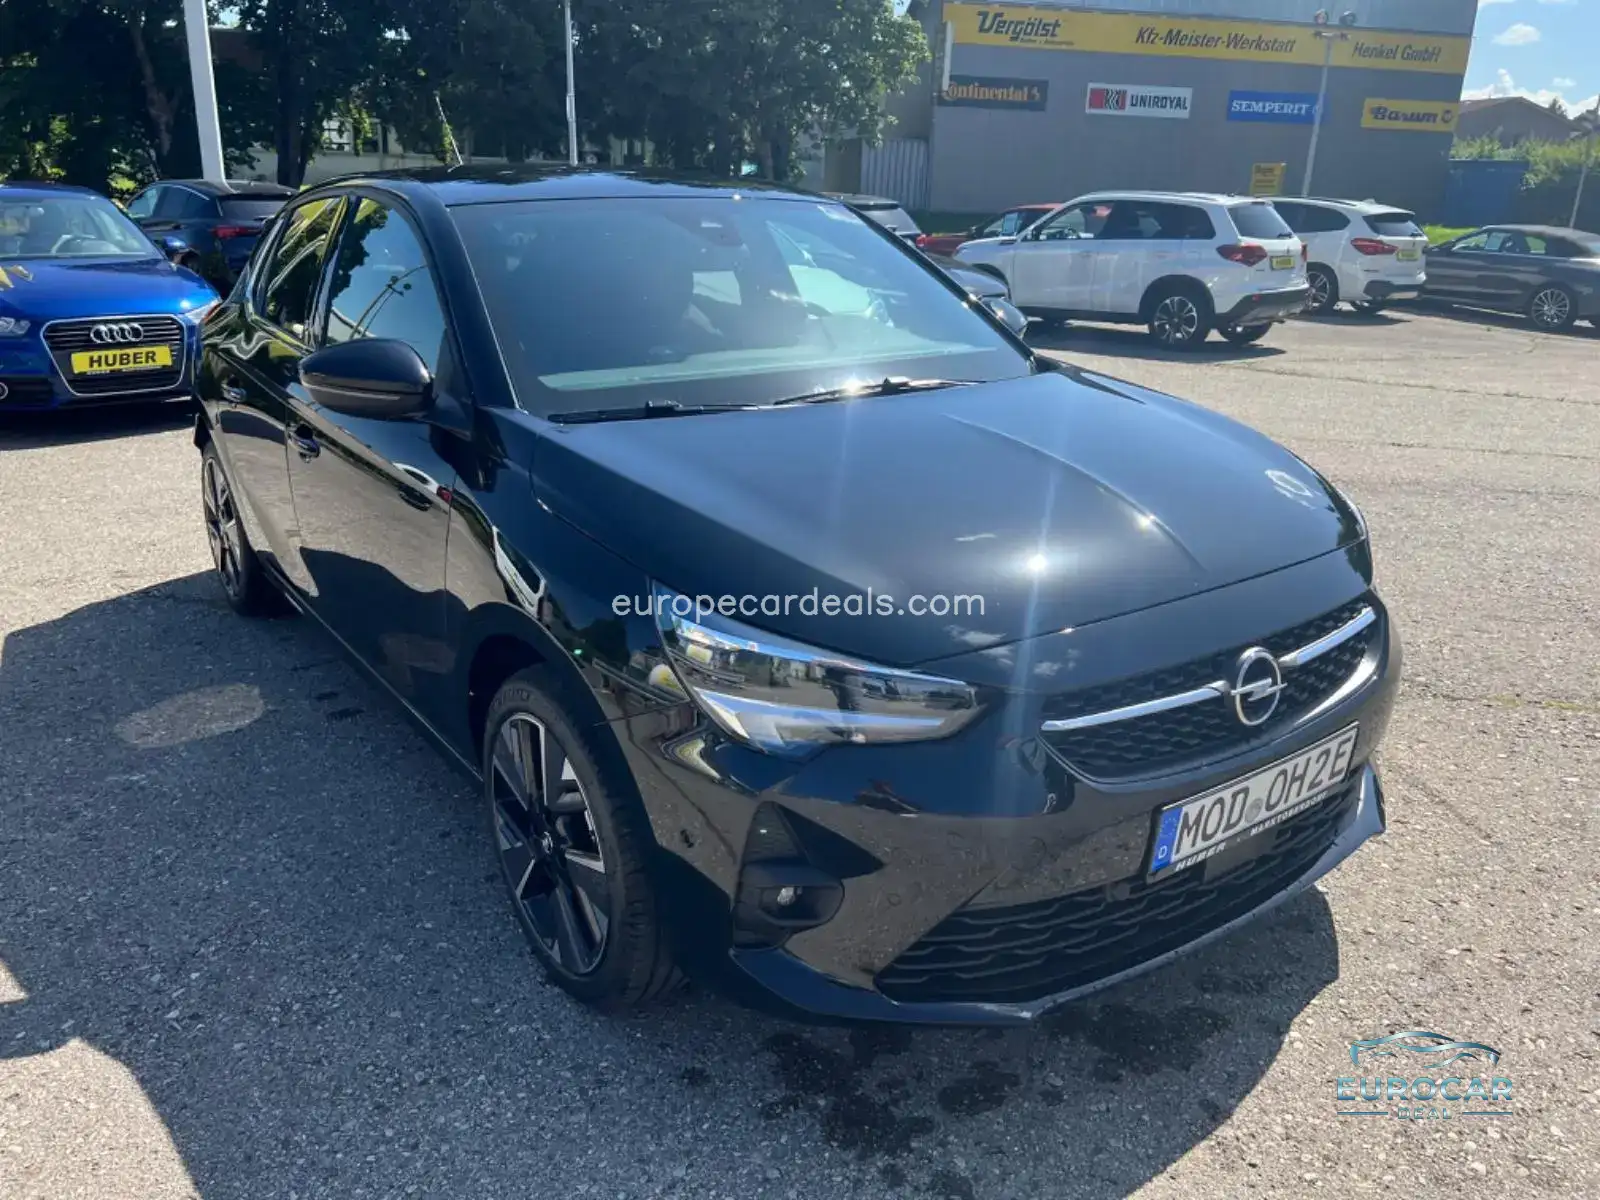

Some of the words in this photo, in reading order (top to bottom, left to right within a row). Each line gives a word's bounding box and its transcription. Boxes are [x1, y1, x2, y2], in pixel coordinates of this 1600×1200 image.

[977, 10, 1061, 42] Vergölst
[1352, 41, 1398, 60] Henkel
[1401, 44, 1442, 63] GmbH
[1129, 93, 1188, 111] UNIROYAL
[1231, 99, 1312, 116] SEMPERIT
[88, 350, 157, 369] HUBER
[1174, 785, 1251, 856] MOD
[1264, 737, 1353, 813] OH2E
[1158, 845, 1168, 860] D
